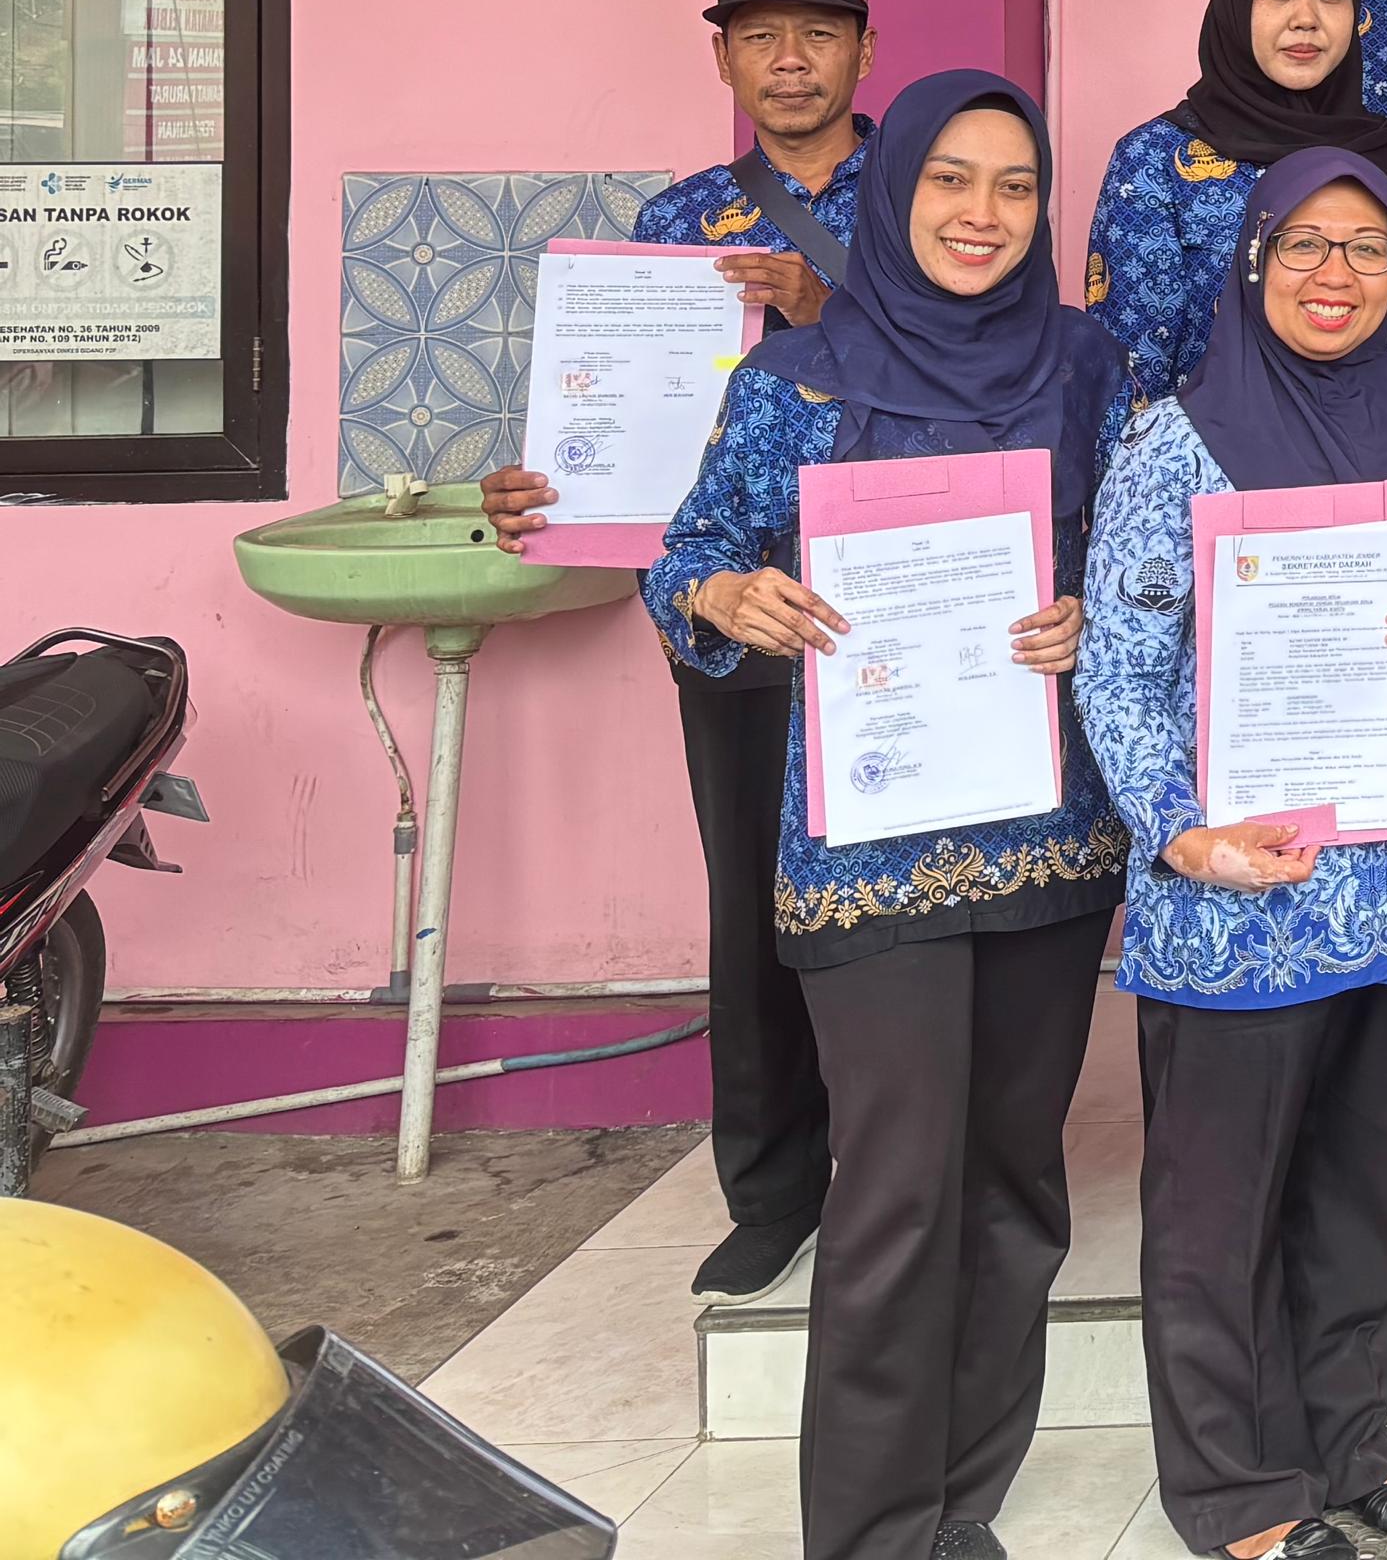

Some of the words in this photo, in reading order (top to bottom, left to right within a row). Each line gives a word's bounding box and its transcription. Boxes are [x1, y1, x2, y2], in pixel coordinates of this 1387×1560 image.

[43, 207, 110, 222] TANPA
[117, 207, 191, 221] ROKOK
[58, 325, 77, 333] NO.
[80, 325, 93, 333] 36
[95, 325, 132, 333] TAHUN
[135, 324, 161, 333] 2009
[13, 335, 27, 343] PP
[30, 335, 48, 343] NO.
[52, 334, 70, 343] 109
[74, 334, 109, 342] TAHUN
[112, 334, 142, 344] 2012)
